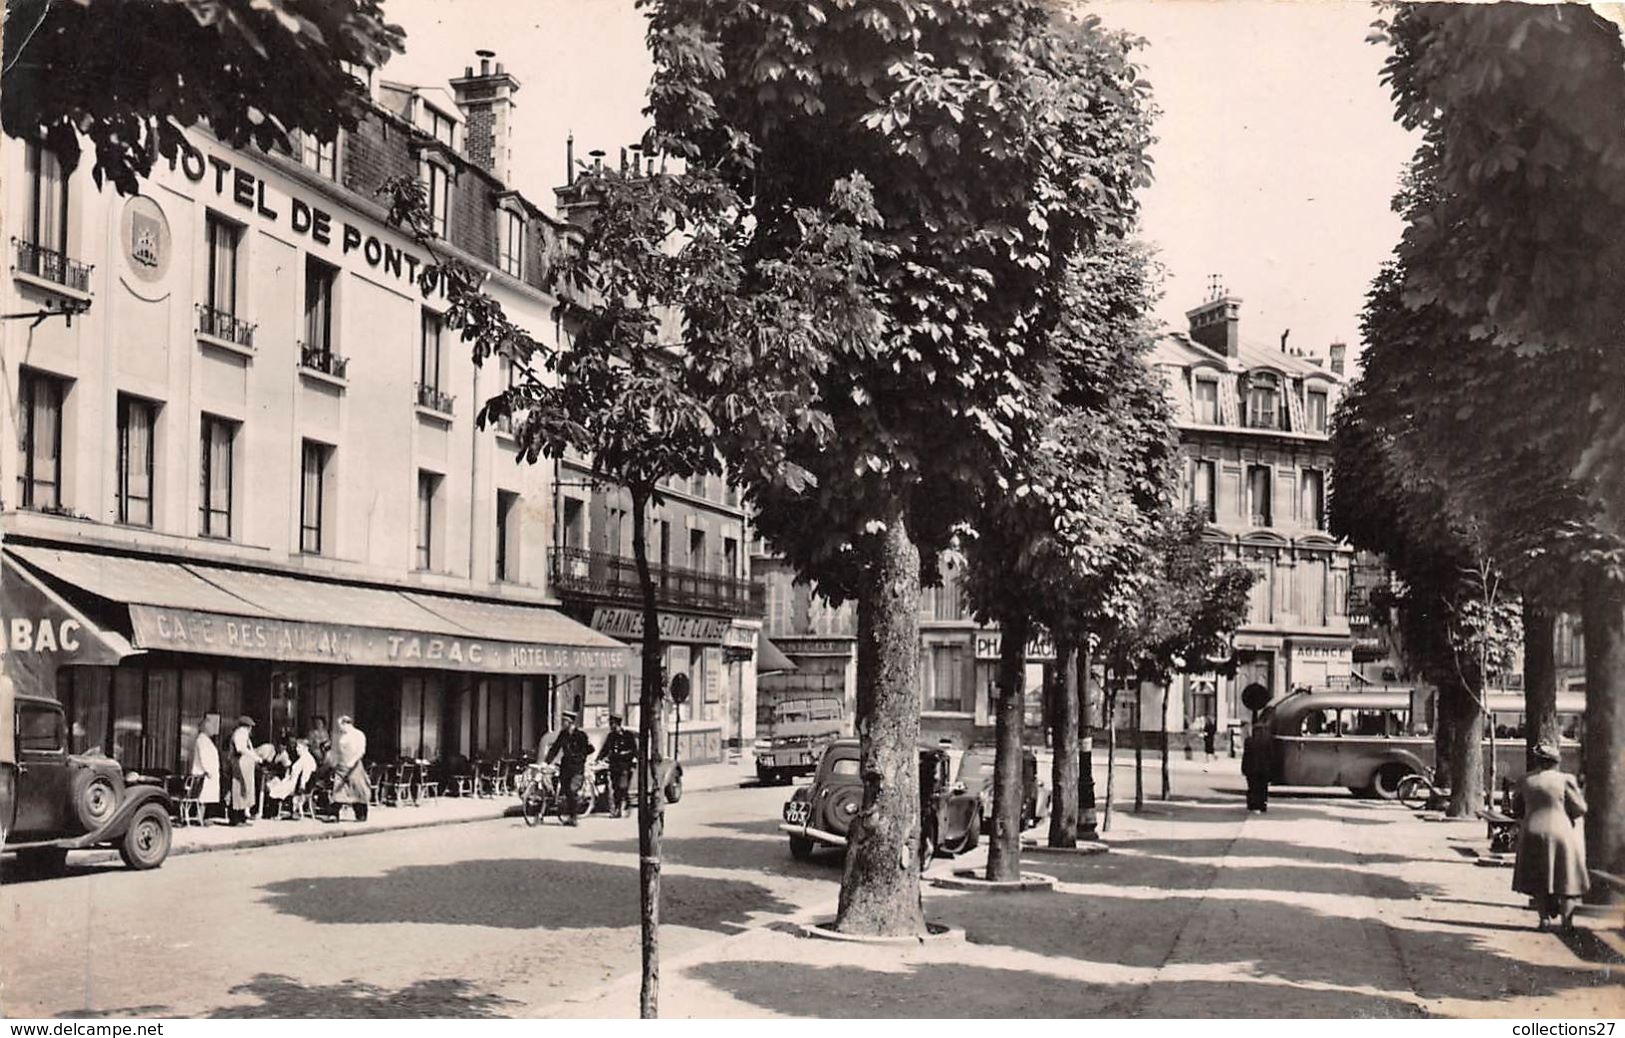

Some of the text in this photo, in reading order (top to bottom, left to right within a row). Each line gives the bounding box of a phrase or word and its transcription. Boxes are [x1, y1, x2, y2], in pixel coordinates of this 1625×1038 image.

[168, 144, 447, 299] OTEL DE PONTOI
[0, 618, 81, 652] BAC
[1349, 614, 1370, 625] AZAR
[388, 634, 483, 664] TABAC
[510, 647, 550, 668] HOTEL
[553, 650, 569, 667] DE
[1296, 647, 1346, 658] AGENCE
